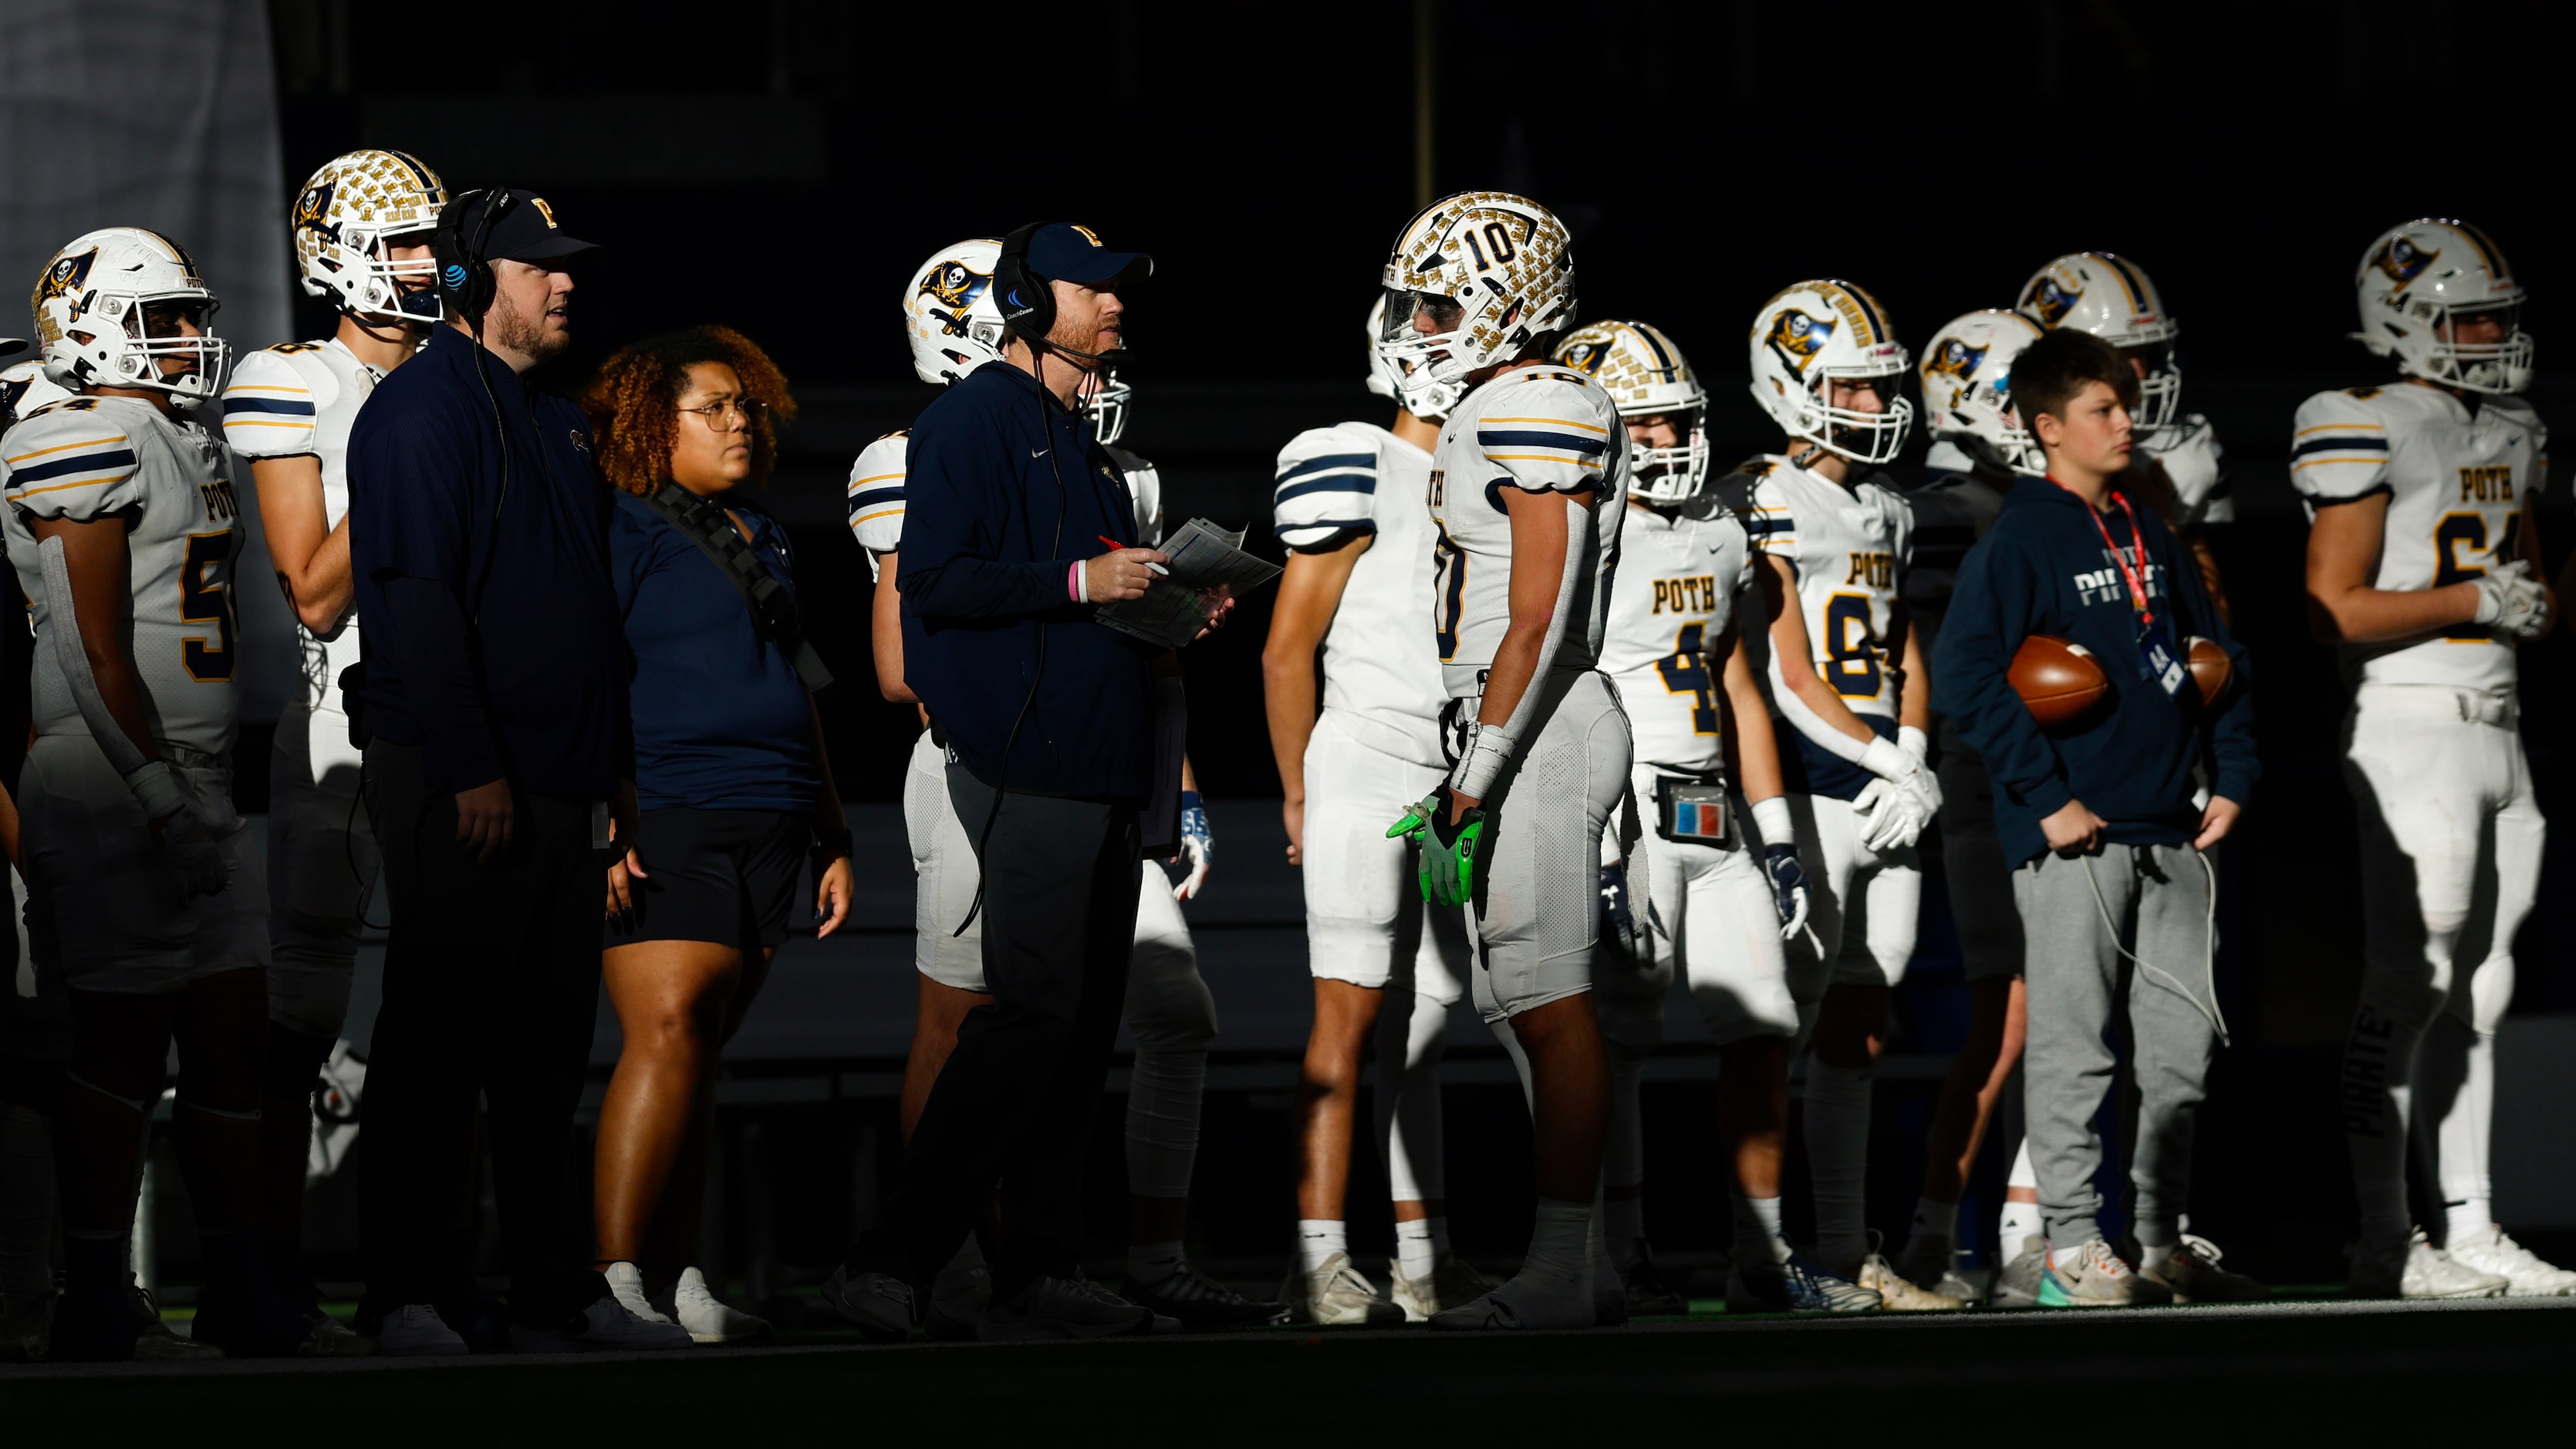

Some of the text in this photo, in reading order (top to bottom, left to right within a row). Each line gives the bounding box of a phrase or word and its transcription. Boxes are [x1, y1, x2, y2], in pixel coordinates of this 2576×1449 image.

[531, 198, 558, 229] P
[1464, 221, 1517, 274] 10
[1006, 307, 1035, 321] CoachComm
[2459, 466, 2514, 503] POTH
[1845, 551, 1894, 589] POTH
[1653, 575, 1716, 615] POTH
[1654, 620, 1720, 736] 4
[2344, 1004, 2392, 1138] PIRATE
